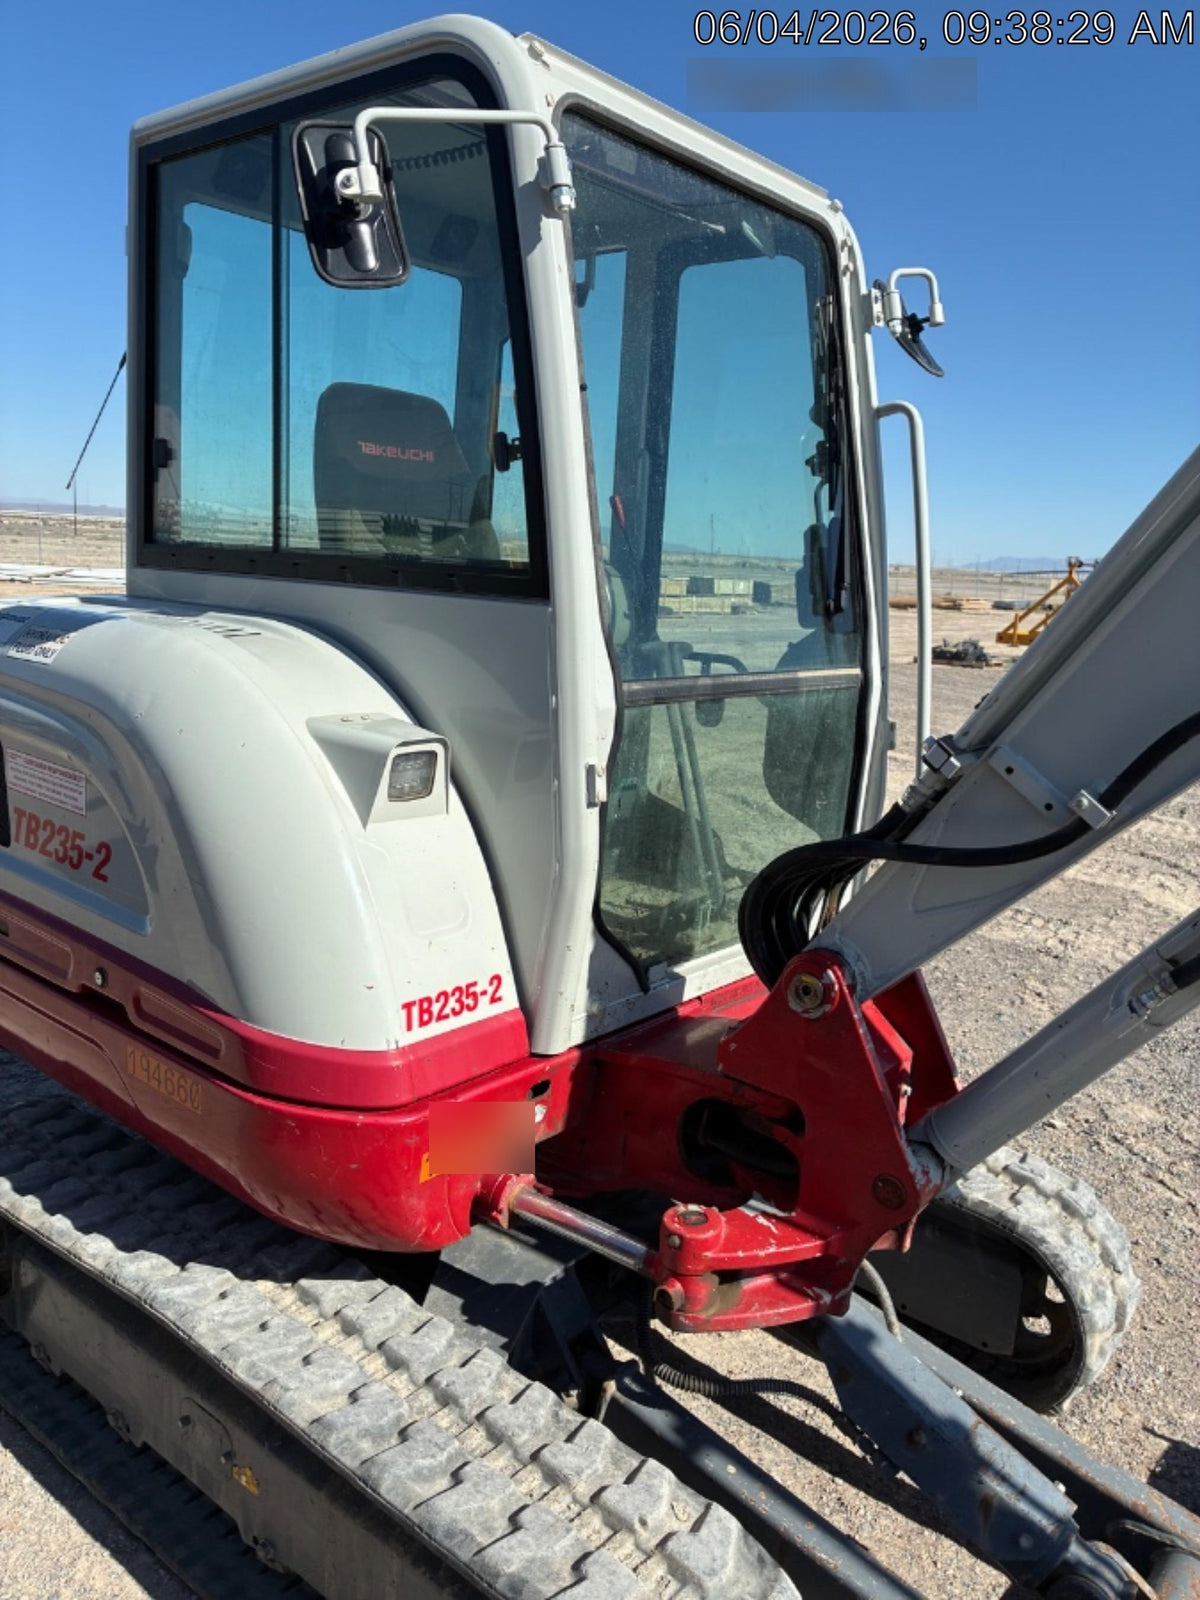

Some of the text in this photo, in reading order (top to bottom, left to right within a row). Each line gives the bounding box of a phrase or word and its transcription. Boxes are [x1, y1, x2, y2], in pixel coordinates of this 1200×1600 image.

[13, 805, 112, 883] TB235-2
[401, 973, 503, 1032] TB235-2
[128, 1047, 200, 1110] 194660
